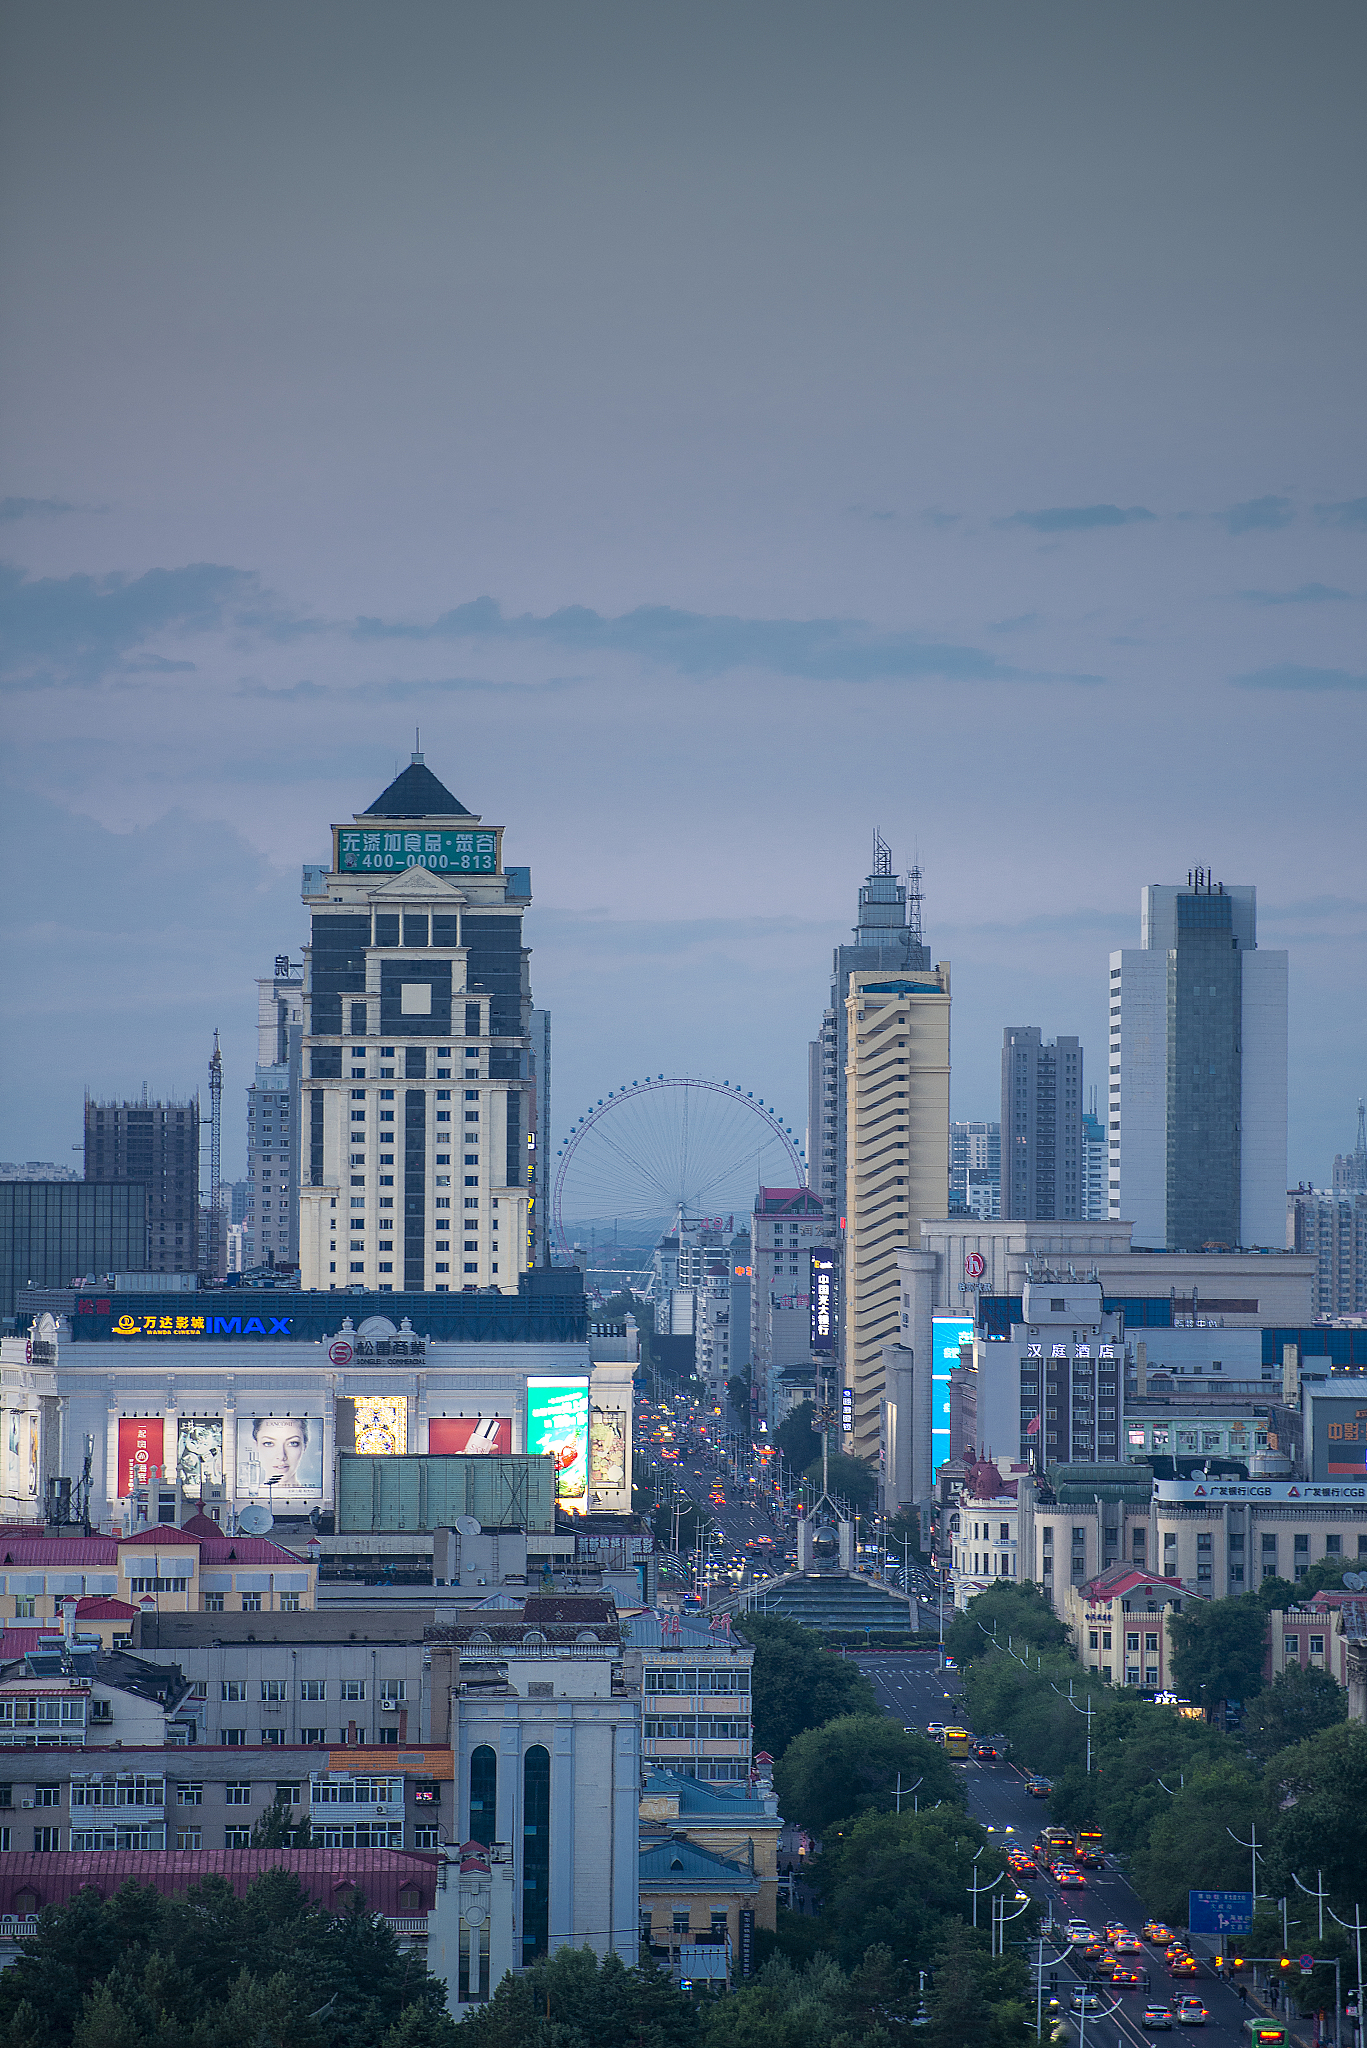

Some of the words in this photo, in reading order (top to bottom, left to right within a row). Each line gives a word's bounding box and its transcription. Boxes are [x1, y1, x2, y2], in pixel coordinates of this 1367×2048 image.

[362, 854, 492, 868] 400-0000-813
[818, 1274, 830, 1335] 中国光大银行
[143, 1316, 204, 1329] 万达影城
[206, 1316, 291, 1334] IMAX
[1027, 1343, 1115, 1358] 汉庭酒店
